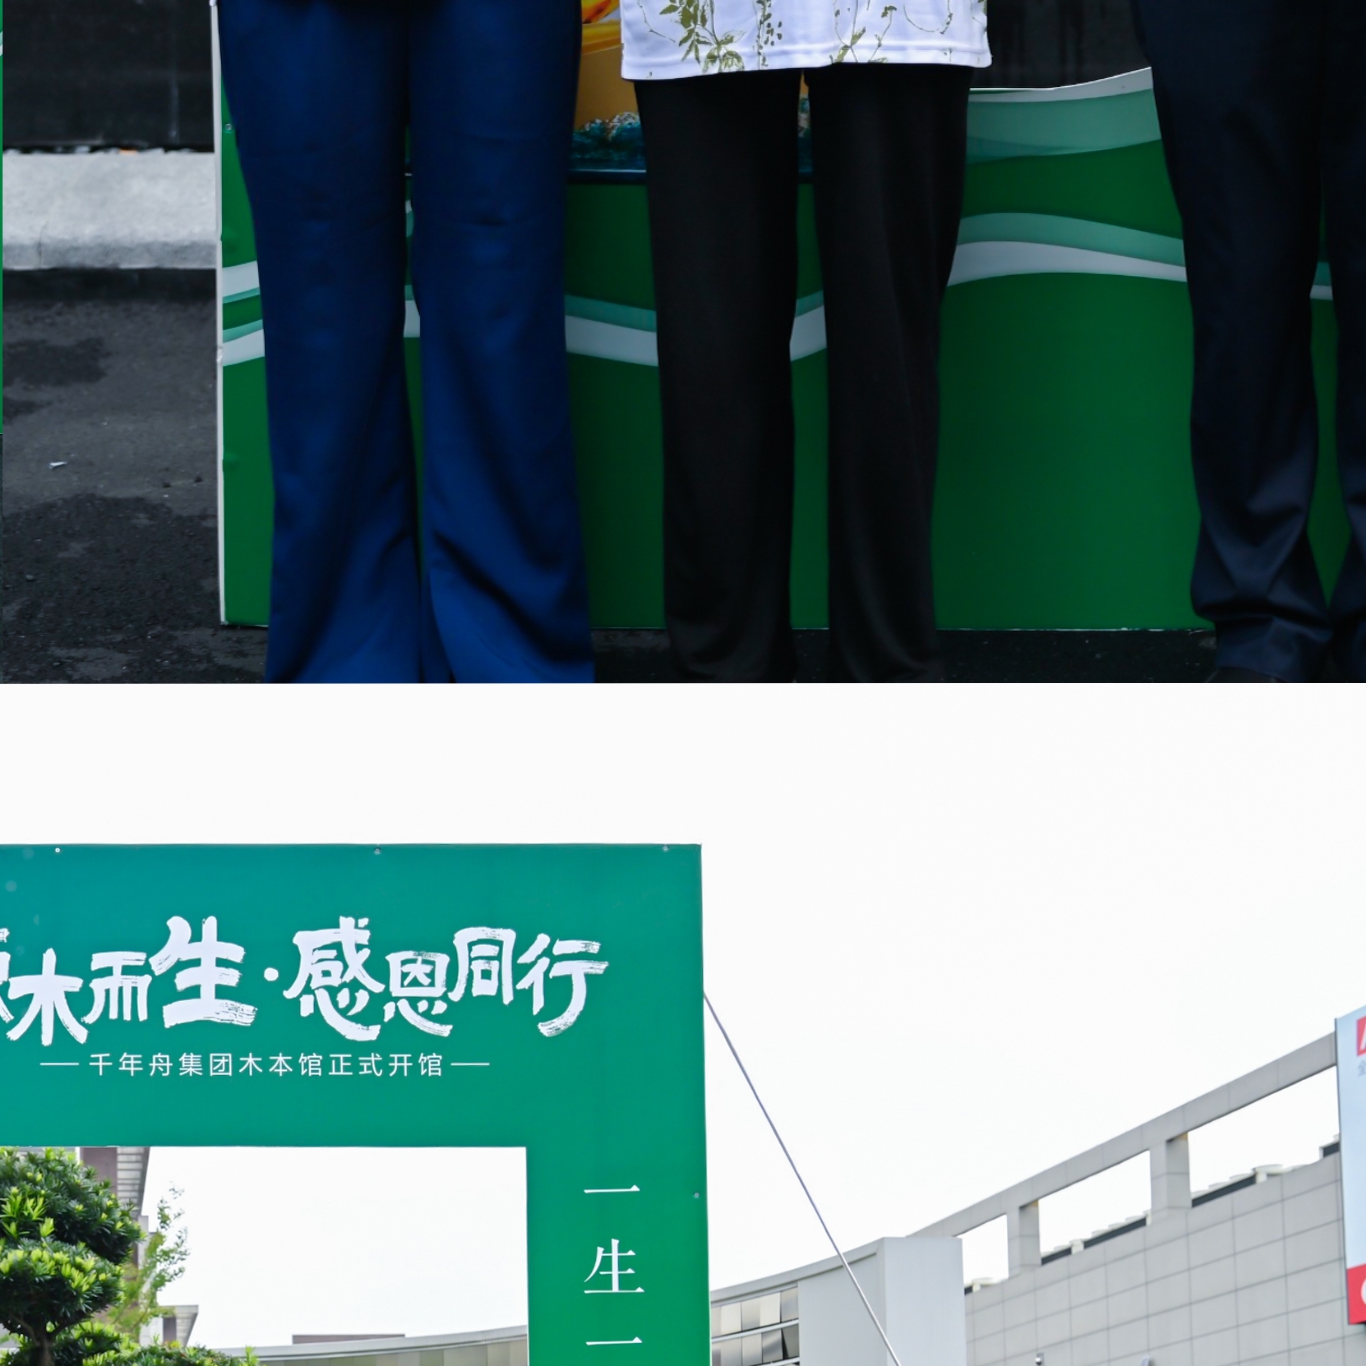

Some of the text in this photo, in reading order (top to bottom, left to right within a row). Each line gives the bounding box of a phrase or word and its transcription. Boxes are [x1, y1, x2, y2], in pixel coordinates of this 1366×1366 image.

[88, 1052, 444, 1078] 千年舟集团木本馆正式开馆
